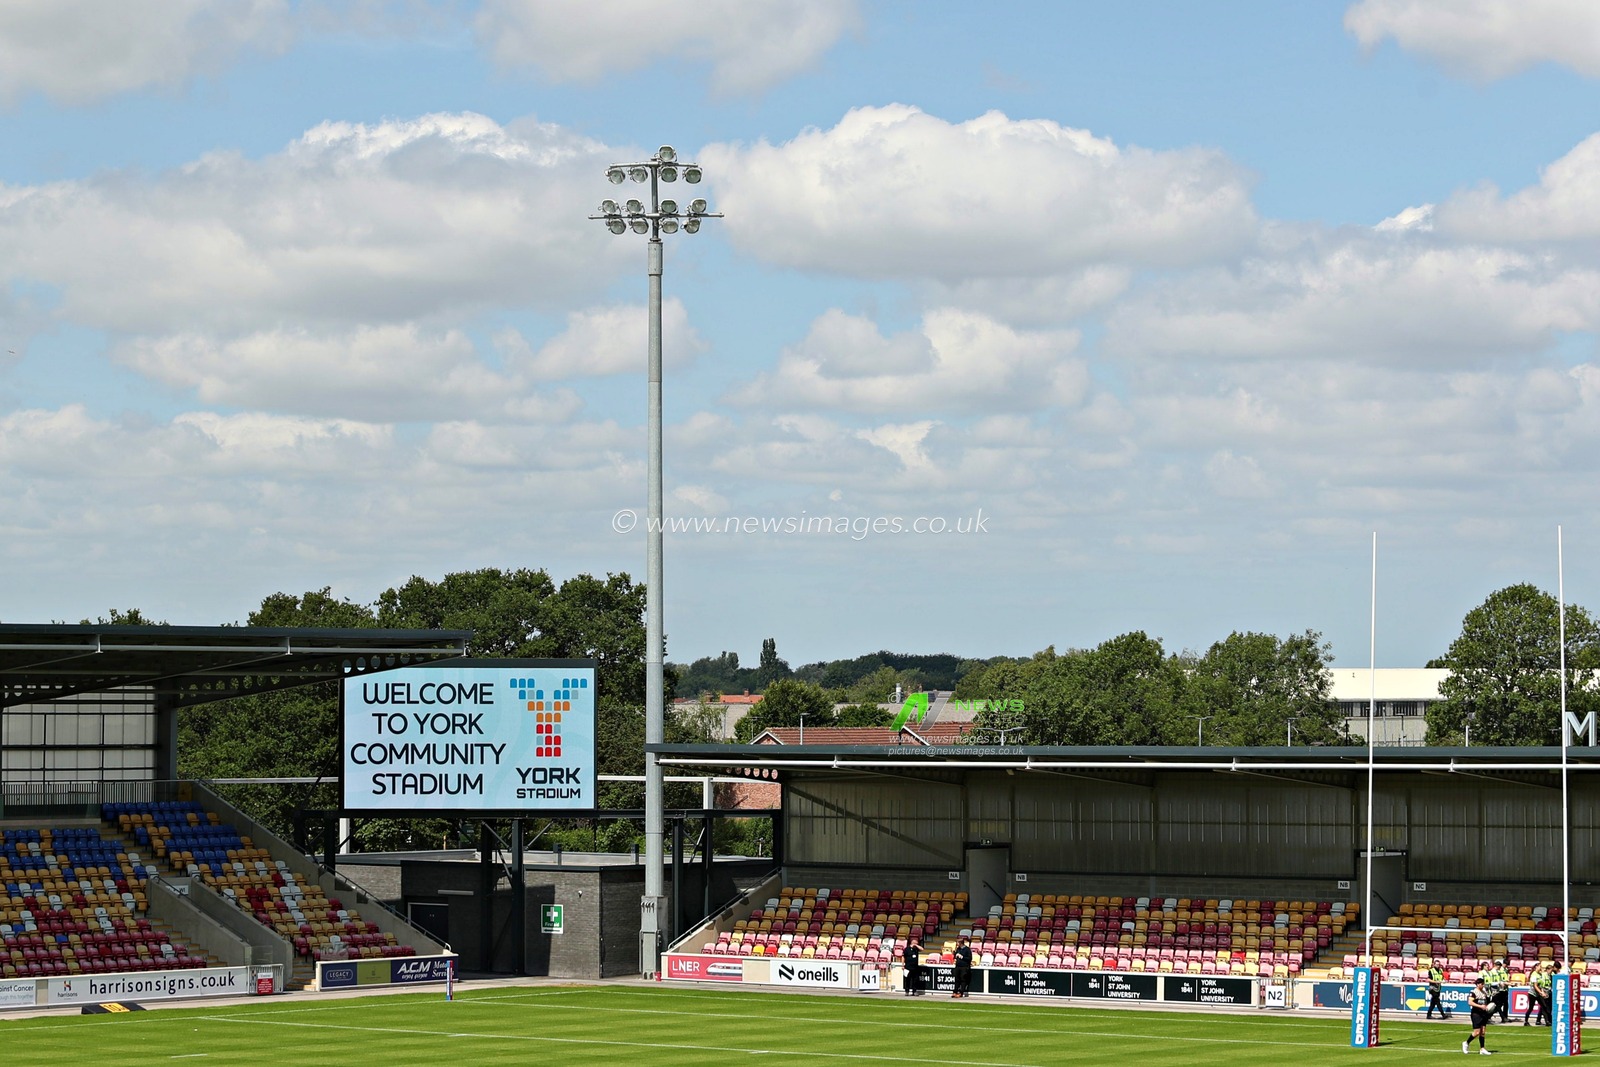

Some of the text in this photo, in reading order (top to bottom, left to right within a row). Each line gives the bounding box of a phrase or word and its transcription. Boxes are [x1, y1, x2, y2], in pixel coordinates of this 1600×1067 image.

[363, 682, 495, 705] WELCOME
[371, 713, 484, 735] TO YORK
[350, 743, 507, 765] COMMUNITY
[371, 773, 483, 795] STADIUM
[516, 767, 581, 785] YORK
[516, 788, 581, 799] STADIUM
[672, 960, 700, 972] LNER
[89, 971, 235, 994] harrisonsigns.co.uk
[861, 975, 877, 984] N1
[1201, 995, 1234, 1003] UNIVERSITY
[1268, 991, 1283, 1001] N2
[1442, 1001, 1457, 1009] Shop
[1354, 971, 1367, 1045] BETFRED
[1370, 972, 1379, 1045] BETFRED
[1556, 979, 1567, 1055] BETFRED
